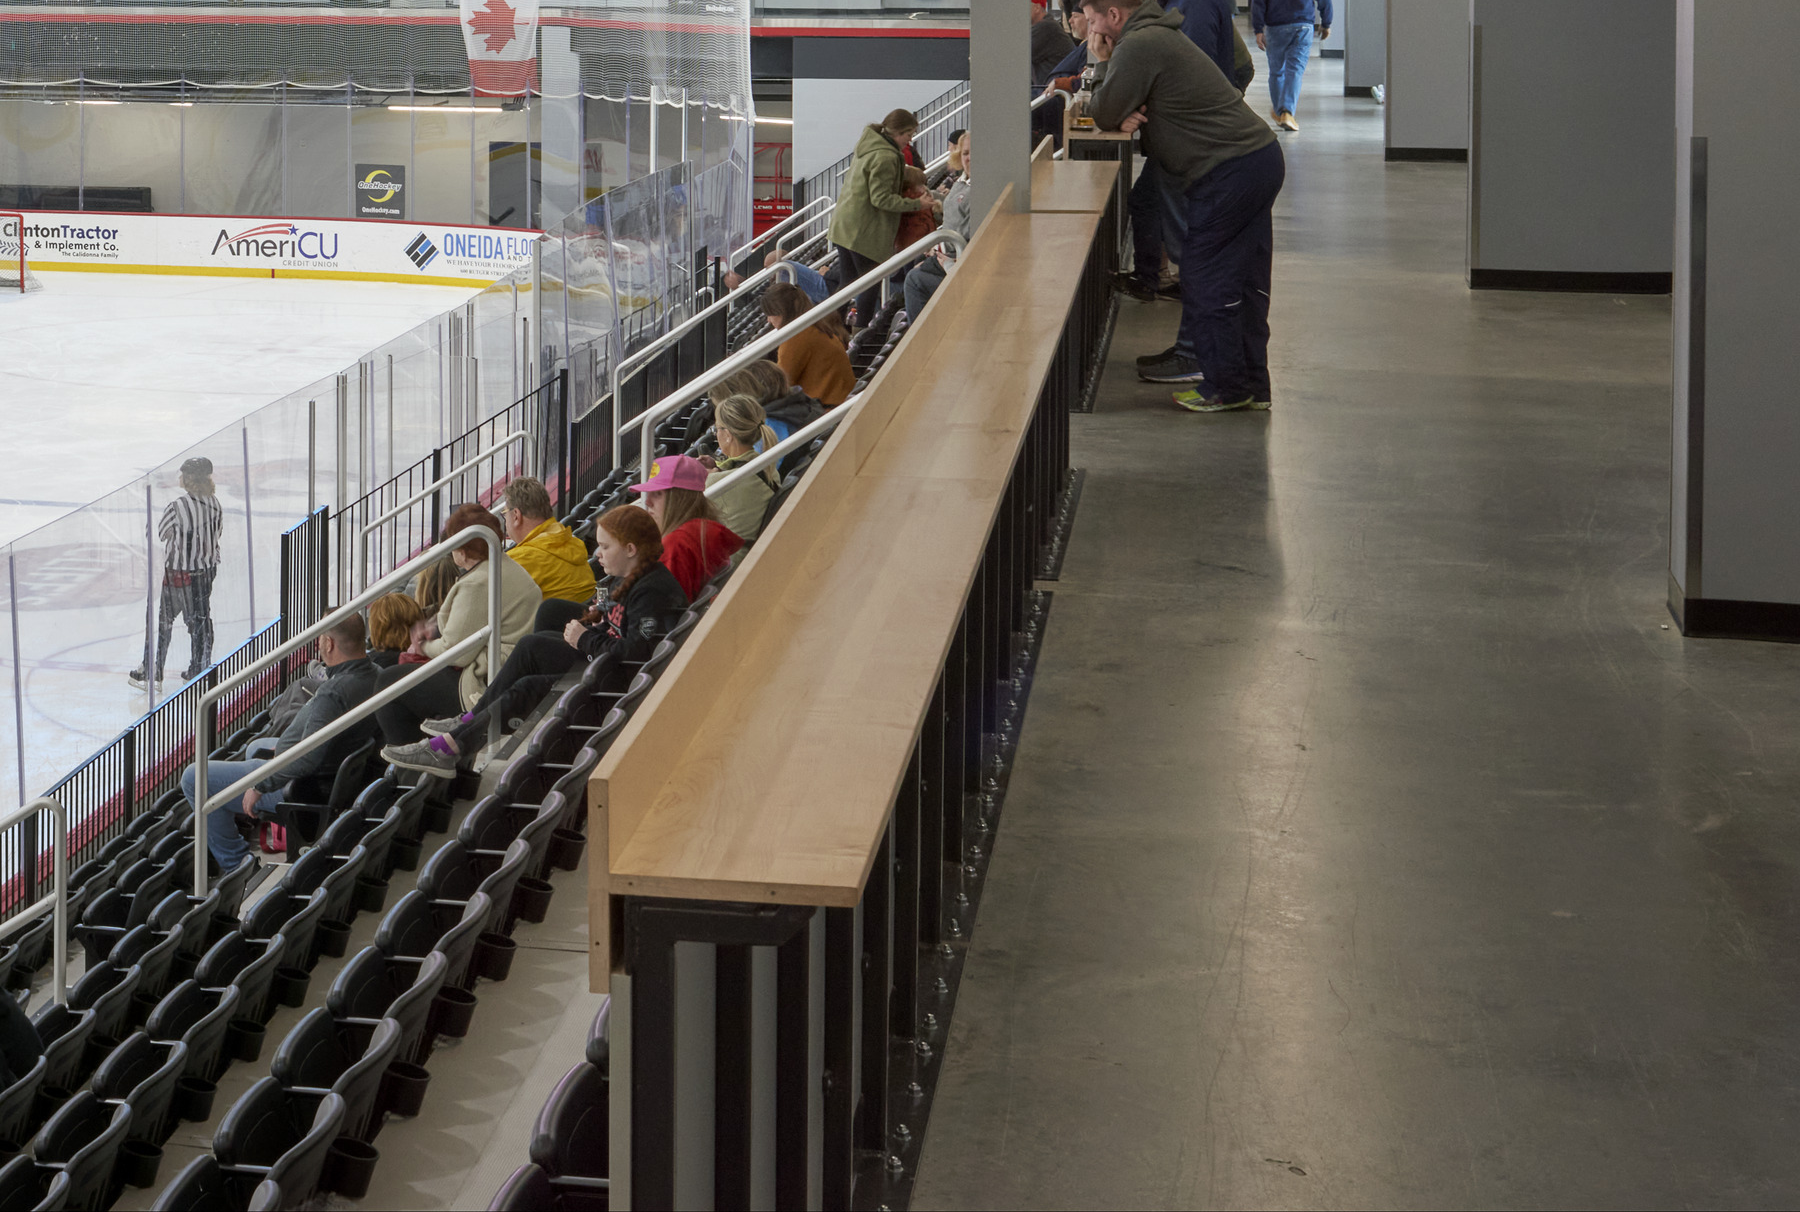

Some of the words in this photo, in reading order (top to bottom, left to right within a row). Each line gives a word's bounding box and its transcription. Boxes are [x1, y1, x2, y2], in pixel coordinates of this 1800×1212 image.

[357, 180, 403, 192] OneHockey
[3, 221, 119, 241] ClntonTractor
[34, 241, 42, 249] &
[45, 240, 101, 252] Implement
[103, 242, 119, 251] Co.
[211, 229, 338, 260] AmeriCU
[443, 232, 504, 260] ONEIDA
[312, 260, 338, 268] UNION
